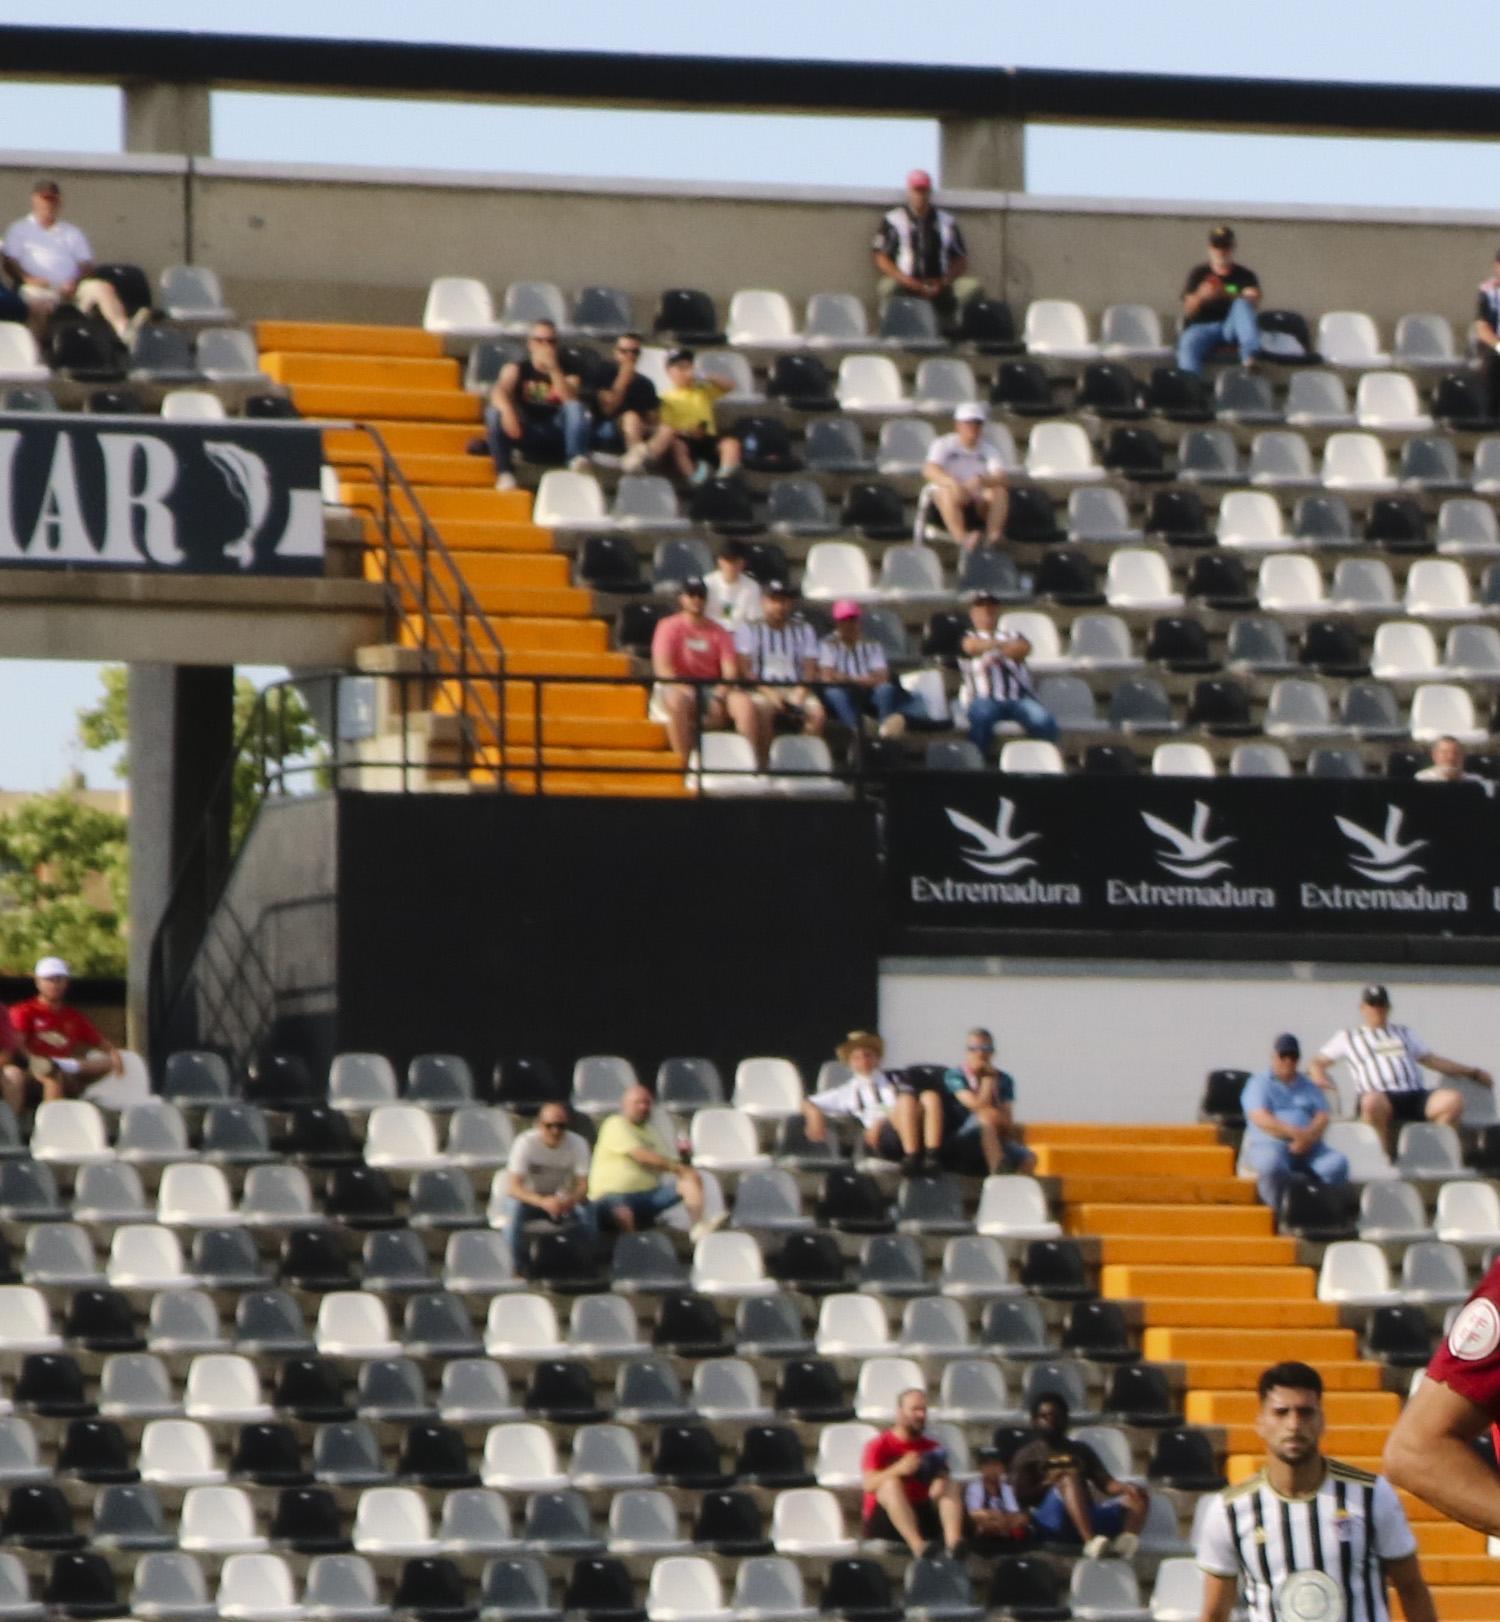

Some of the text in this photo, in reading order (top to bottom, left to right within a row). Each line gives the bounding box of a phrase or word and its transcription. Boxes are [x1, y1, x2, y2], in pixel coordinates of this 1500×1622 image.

[911, 875, 1082, 906] Extremadura
[1106, 878, 1277, 910] Extremadura
[1300, 881, 1469, 913] Extremadura
